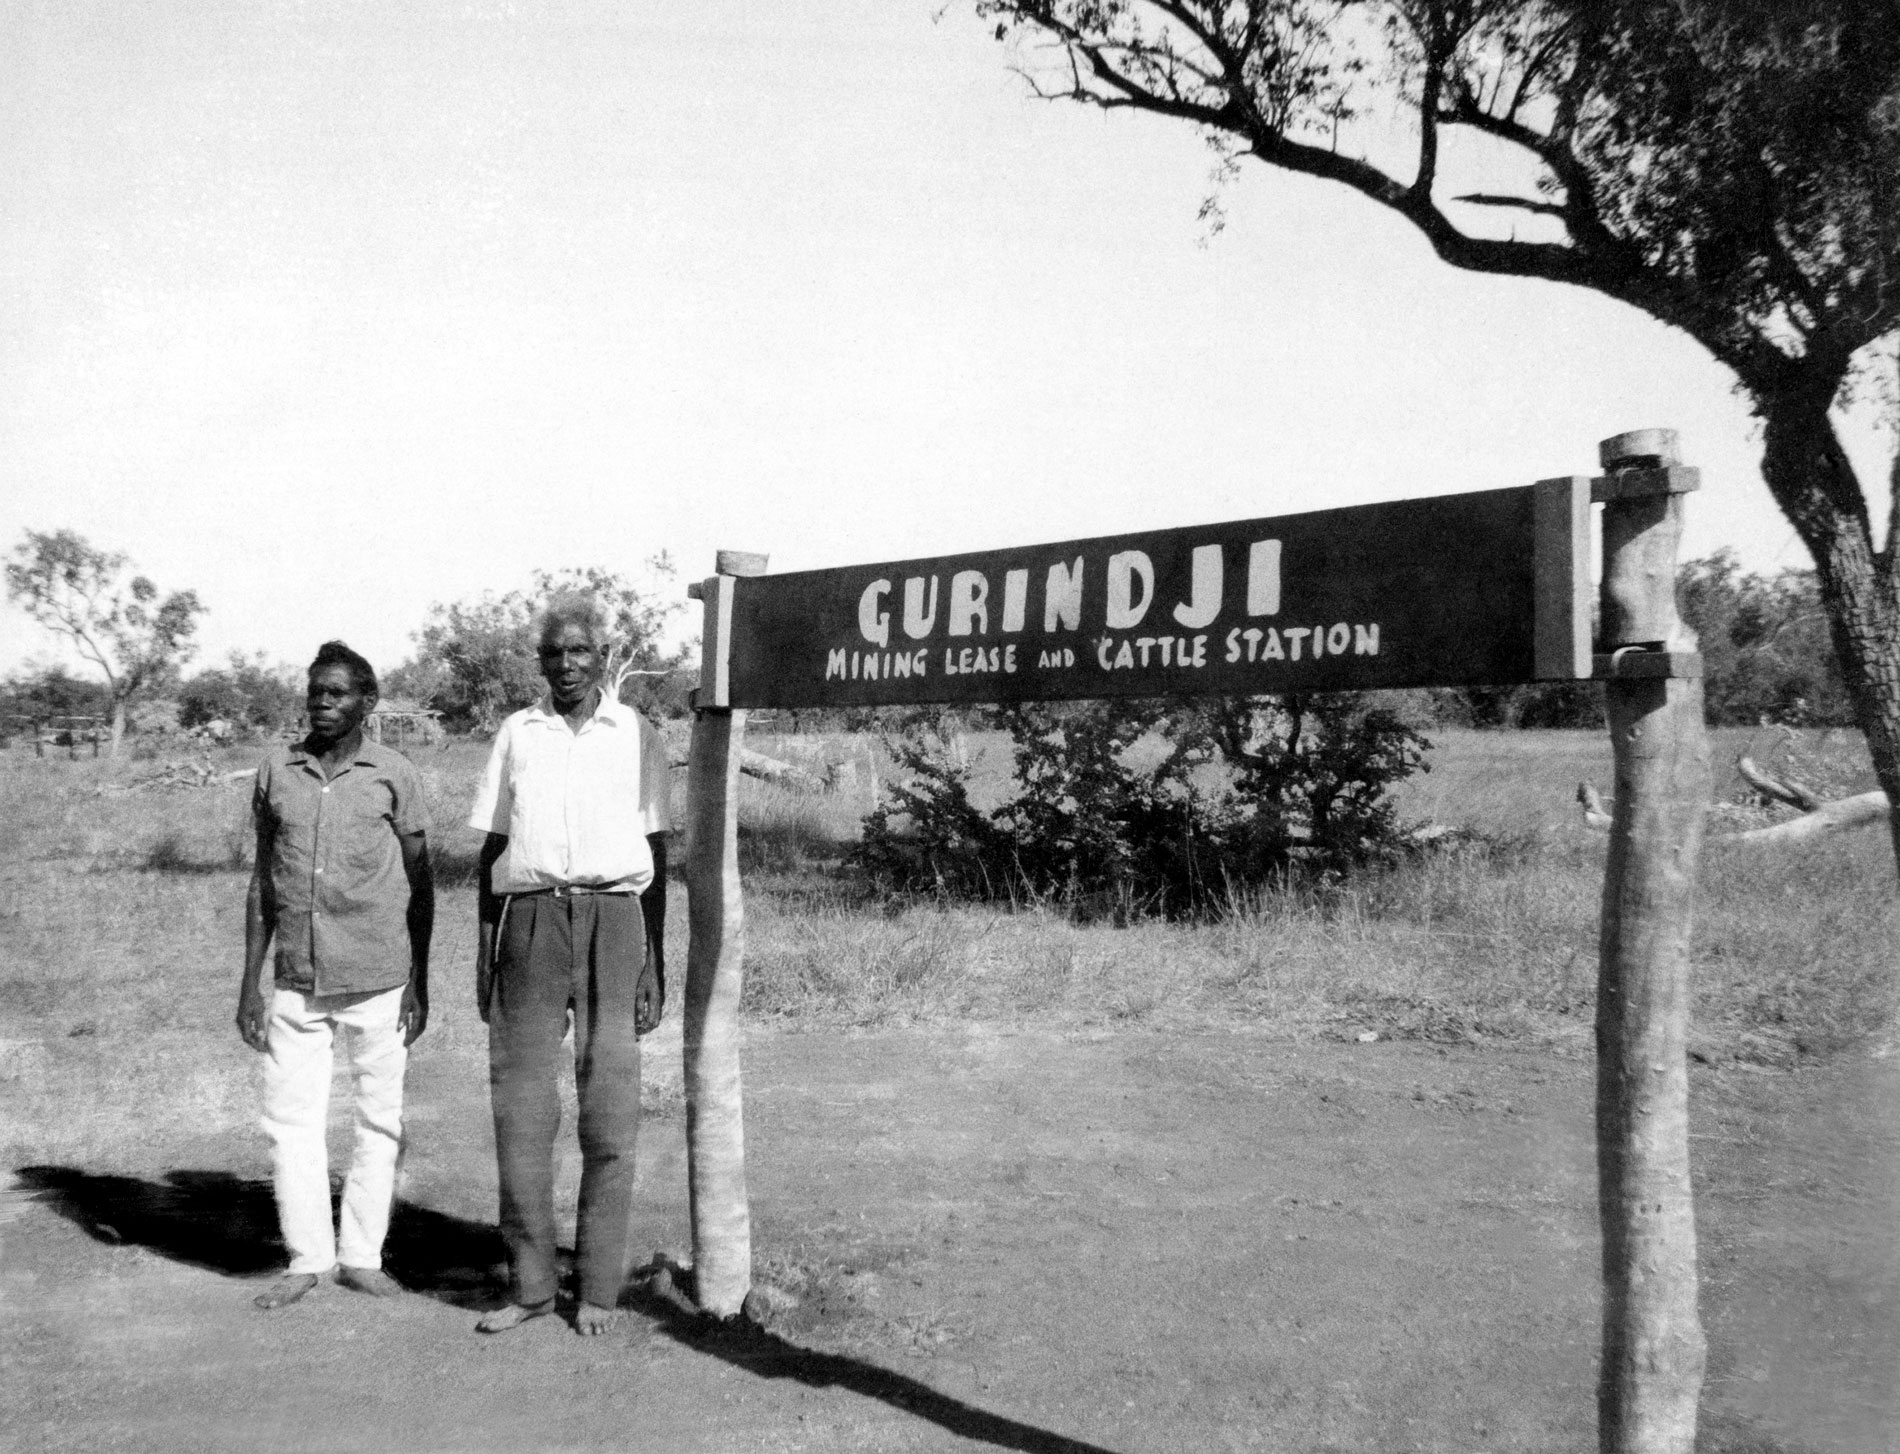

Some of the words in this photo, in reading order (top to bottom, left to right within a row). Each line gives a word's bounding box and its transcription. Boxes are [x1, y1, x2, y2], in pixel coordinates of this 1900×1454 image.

[858, 538, 1282, 648] GURINDJI
[825, 647, 929, 681] MINING
[945, 644, 1017, 676] LEASE
[1038, 648, 1075, 669] AND
[1097, 635, 1208, 671] CATTLE
[1225, 622, 1380, 663] STATION
